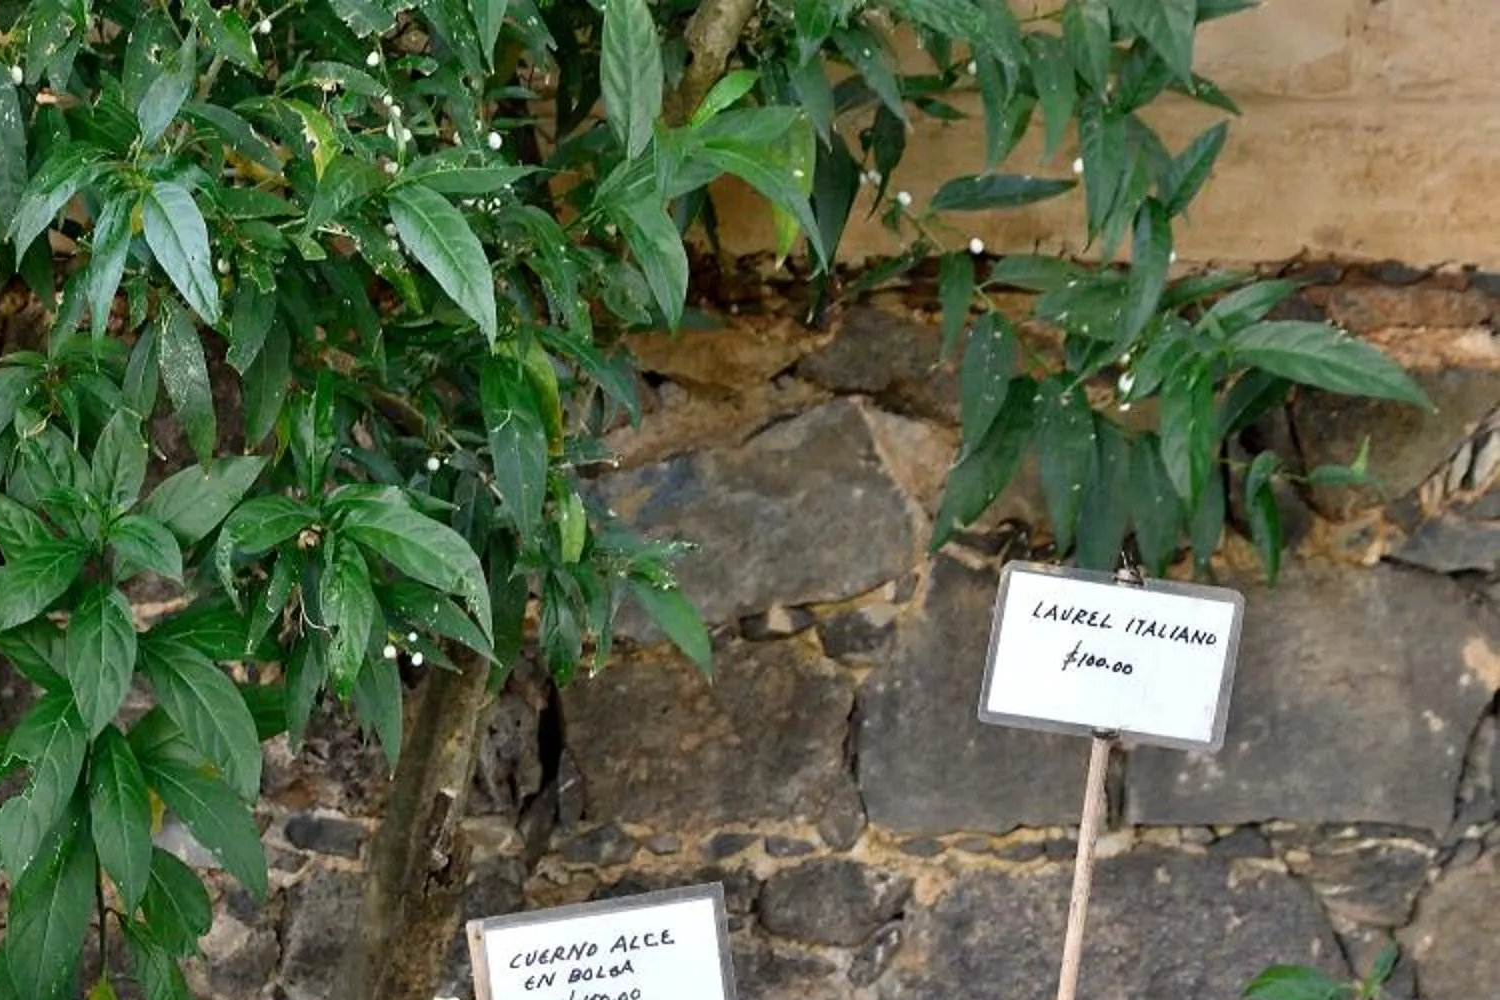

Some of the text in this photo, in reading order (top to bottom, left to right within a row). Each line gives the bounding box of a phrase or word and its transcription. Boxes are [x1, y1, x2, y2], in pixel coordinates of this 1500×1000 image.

[1031, 600, 1218, 646] LAUREL ITALIANO
[1061, 639, 1134, 676] $100.00
[509, 928, 676, 970] CUERNO ALCE
[523, 971, 557, 991] EN
